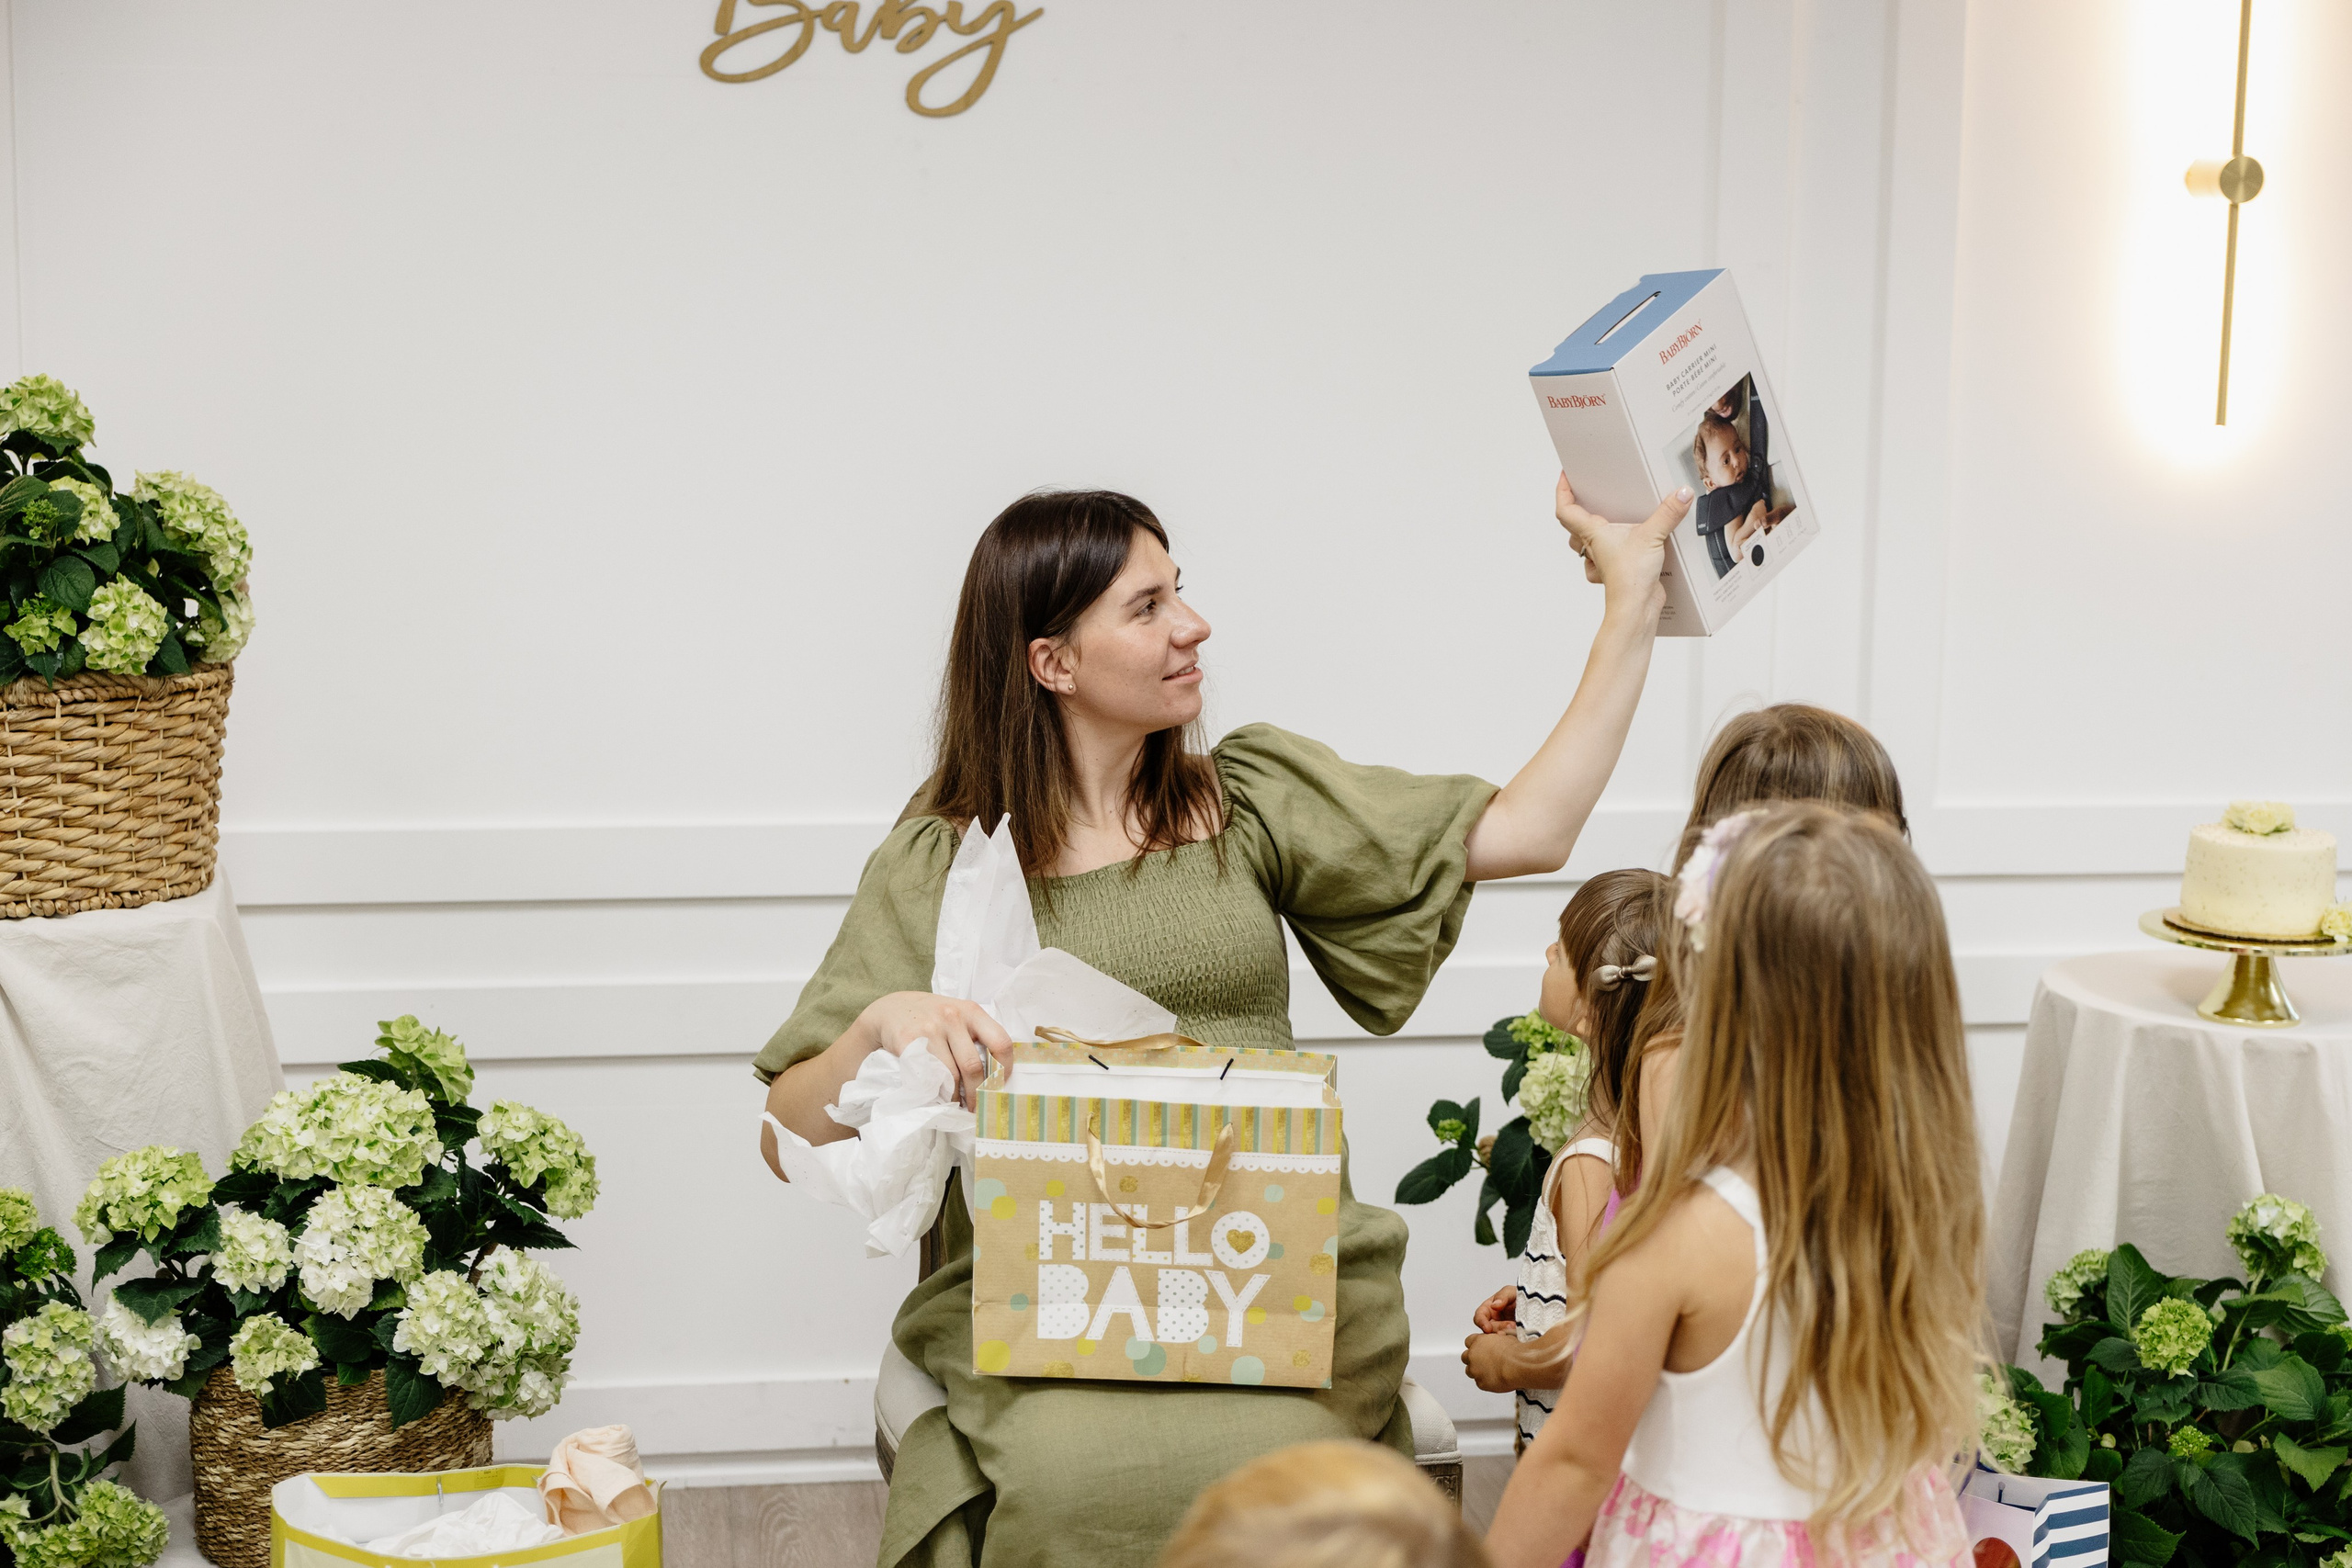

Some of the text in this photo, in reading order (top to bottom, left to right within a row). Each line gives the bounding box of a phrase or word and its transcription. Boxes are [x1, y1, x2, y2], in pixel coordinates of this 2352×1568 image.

[1666, 343, 1716, 390] BABY CARRIER MINI
[1703, 354, 1716, 369] MINI
[1038, 1200, 1270, 1269] HELLO
[1037, 1264, 1272, 1348] BABY
